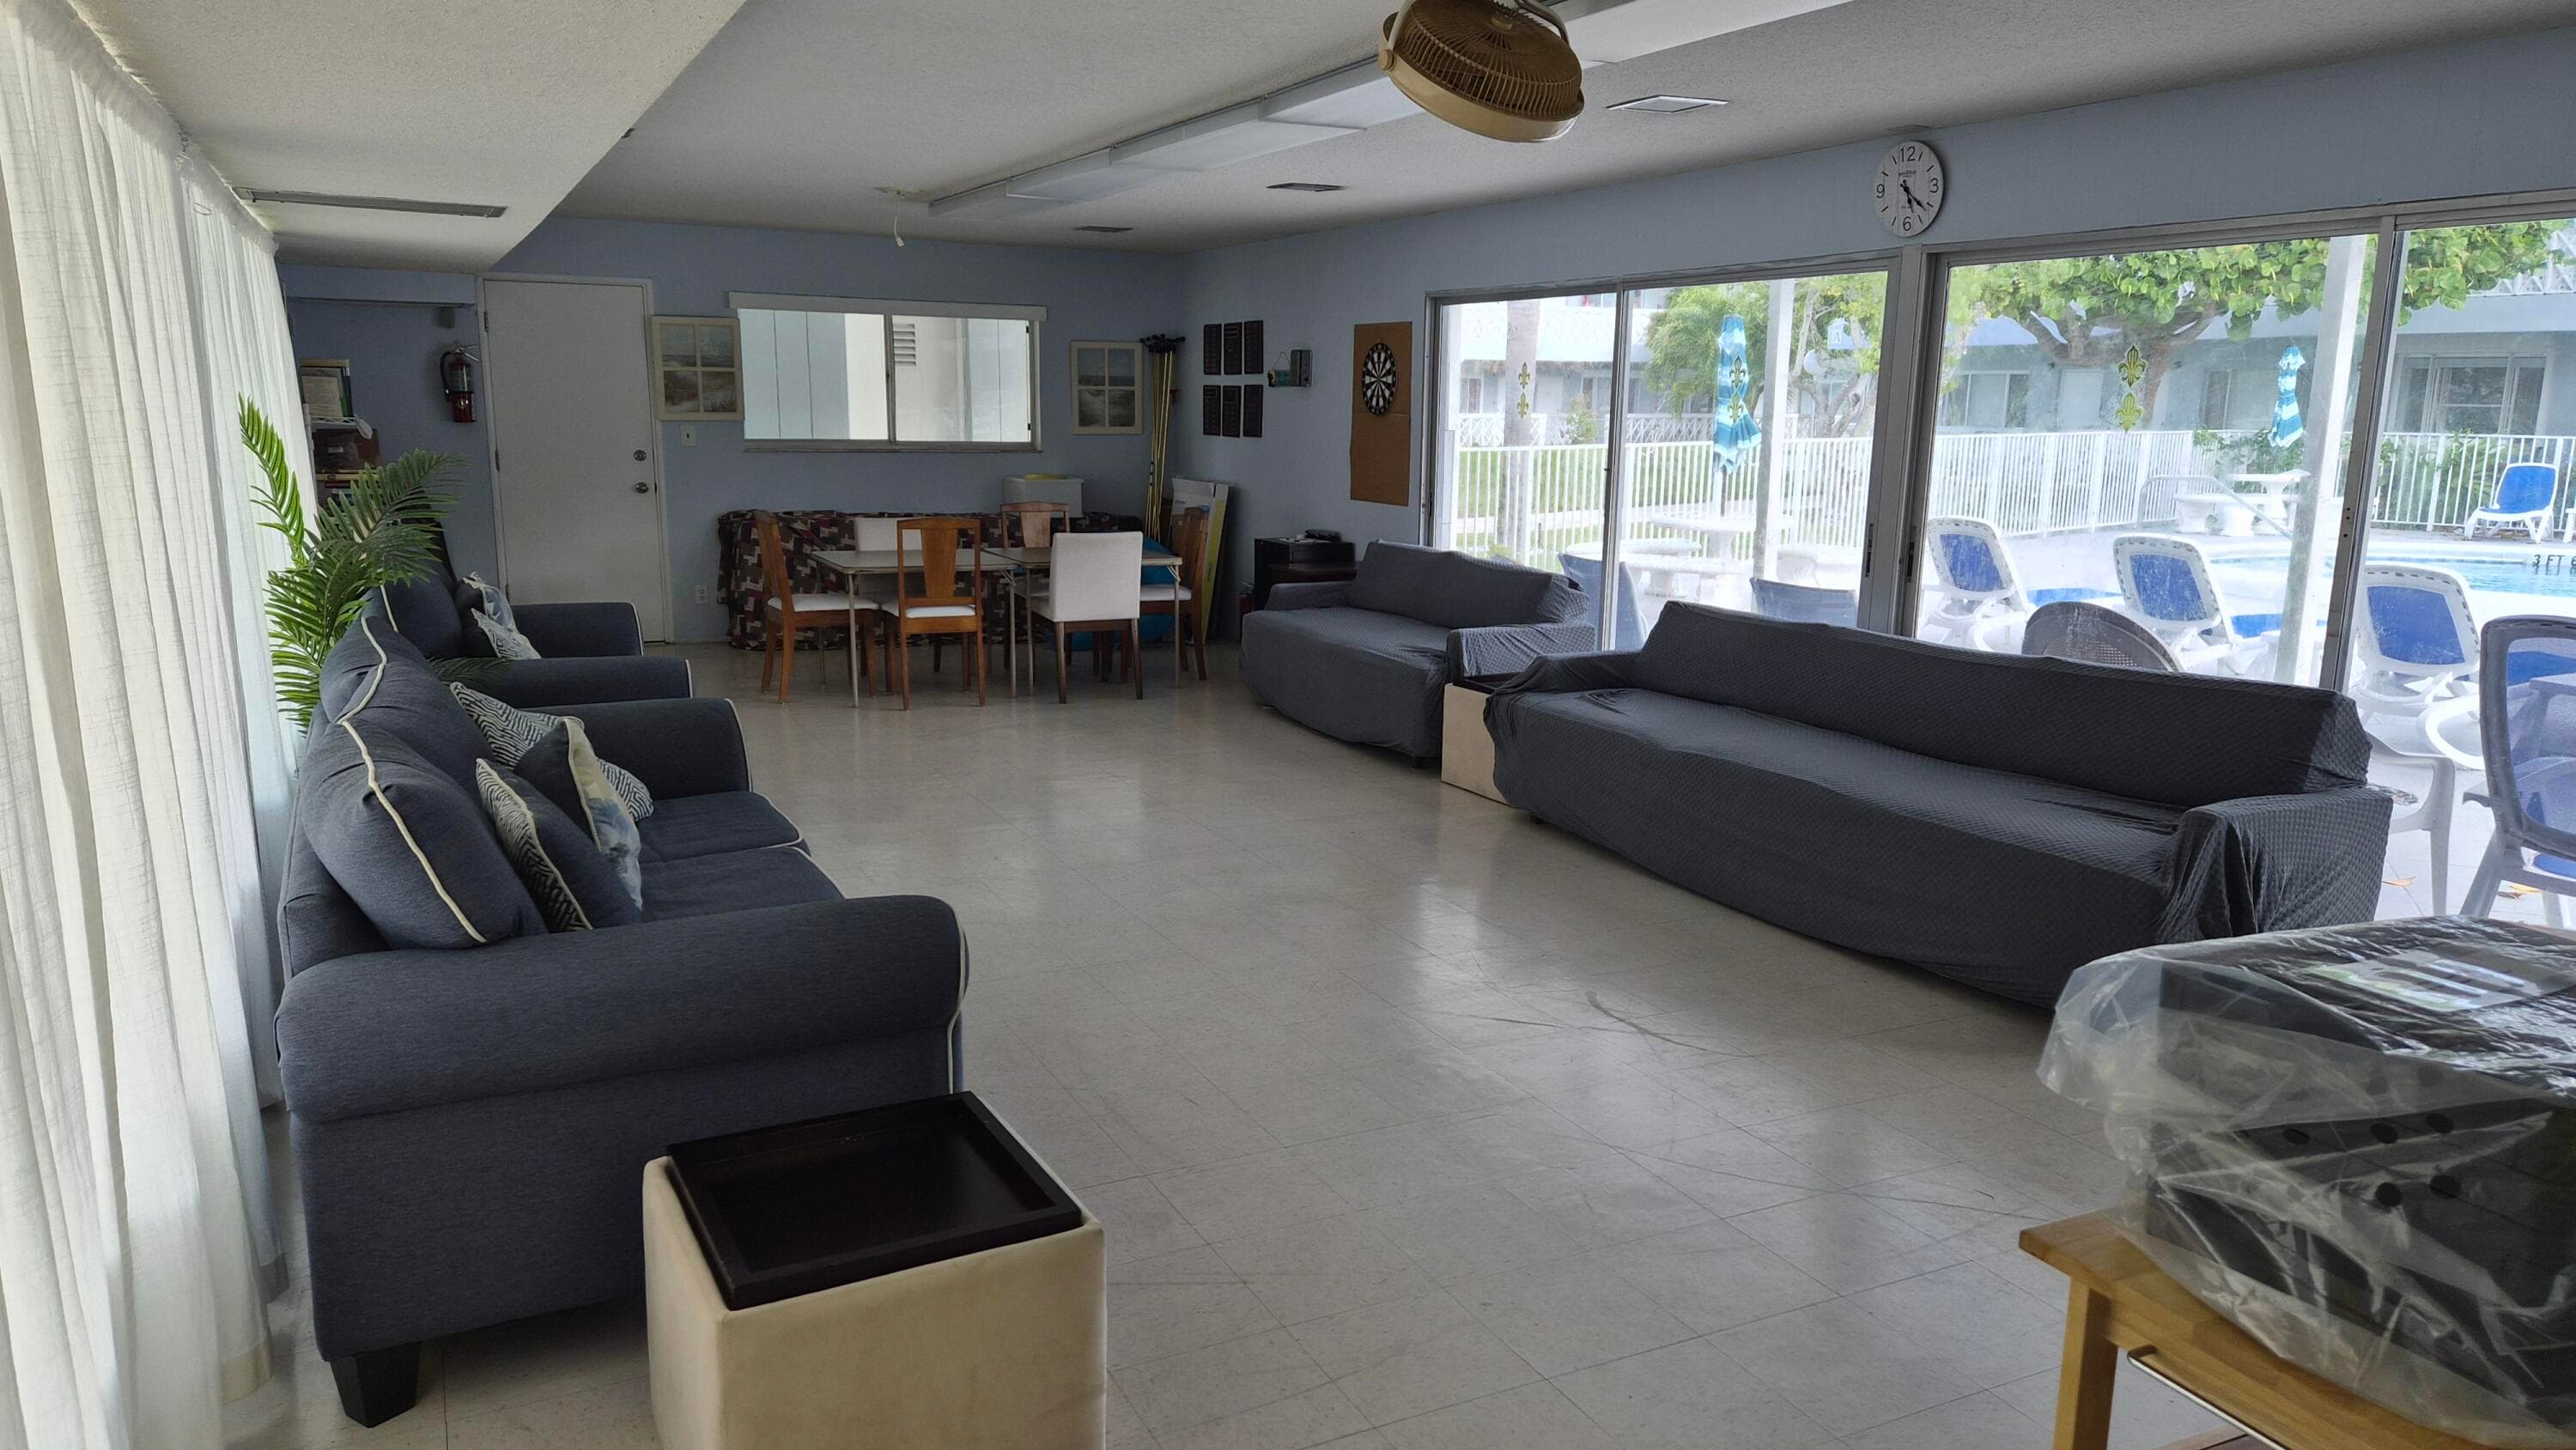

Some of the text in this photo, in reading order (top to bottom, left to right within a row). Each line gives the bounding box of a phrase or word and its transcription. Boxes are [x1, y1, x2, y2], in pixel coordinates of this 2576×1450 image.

[1900, 146, 1916, 162] 12
[1876, 184, 1885, 199] 9
[1930, 178, 1939, 193] 3
[1903, 215, 1912, 232] 6
[2532, 555, 2541, 566] 3
[2545, 555, 2566, 567] FT
